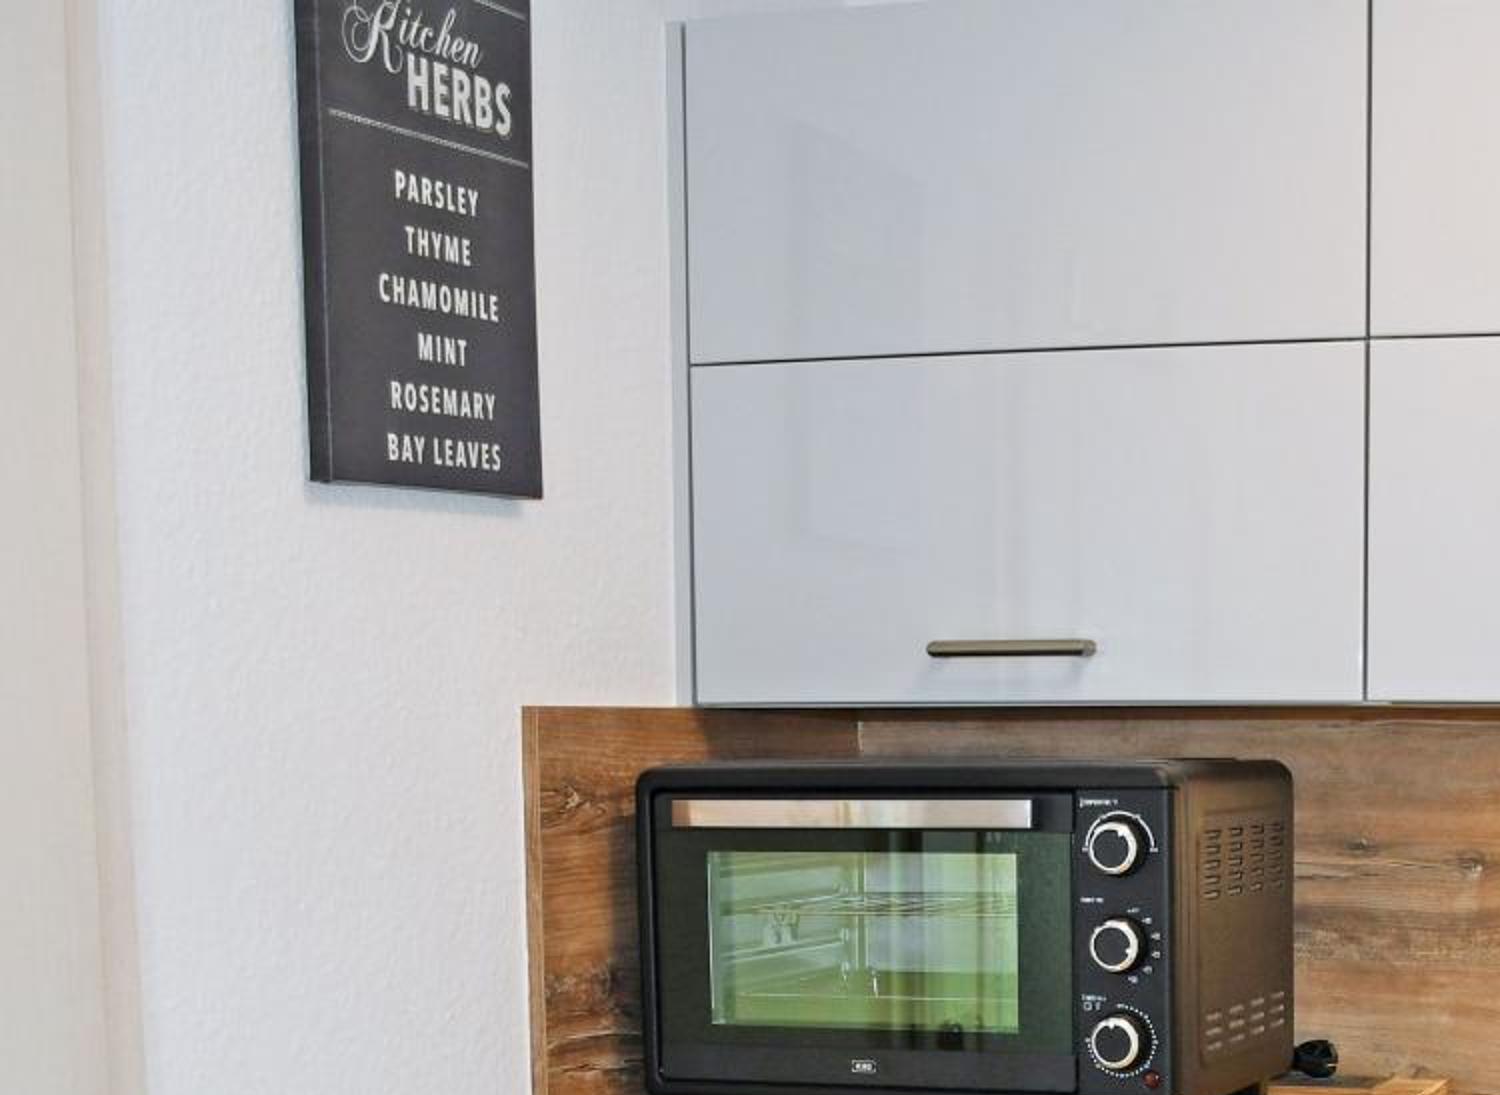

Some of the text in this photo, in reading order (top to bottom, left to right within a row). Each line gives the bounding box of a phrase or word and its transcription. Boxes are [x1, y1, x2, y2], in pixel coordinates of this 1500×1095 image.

[342, 0, 483, 73] Kitchen
[407, 53, 511, 136] HERBS
[395, 170, 478, 216] PARSLEY
[405, 226, 471, 266] THYME
[379, 273, 499, 322] CHAMOMILE
[418, 333, 467, 366] MINT
[391, 381, 496, 420] ROSEMARY
[387, 433, 501, 471] BAY LEAVES
